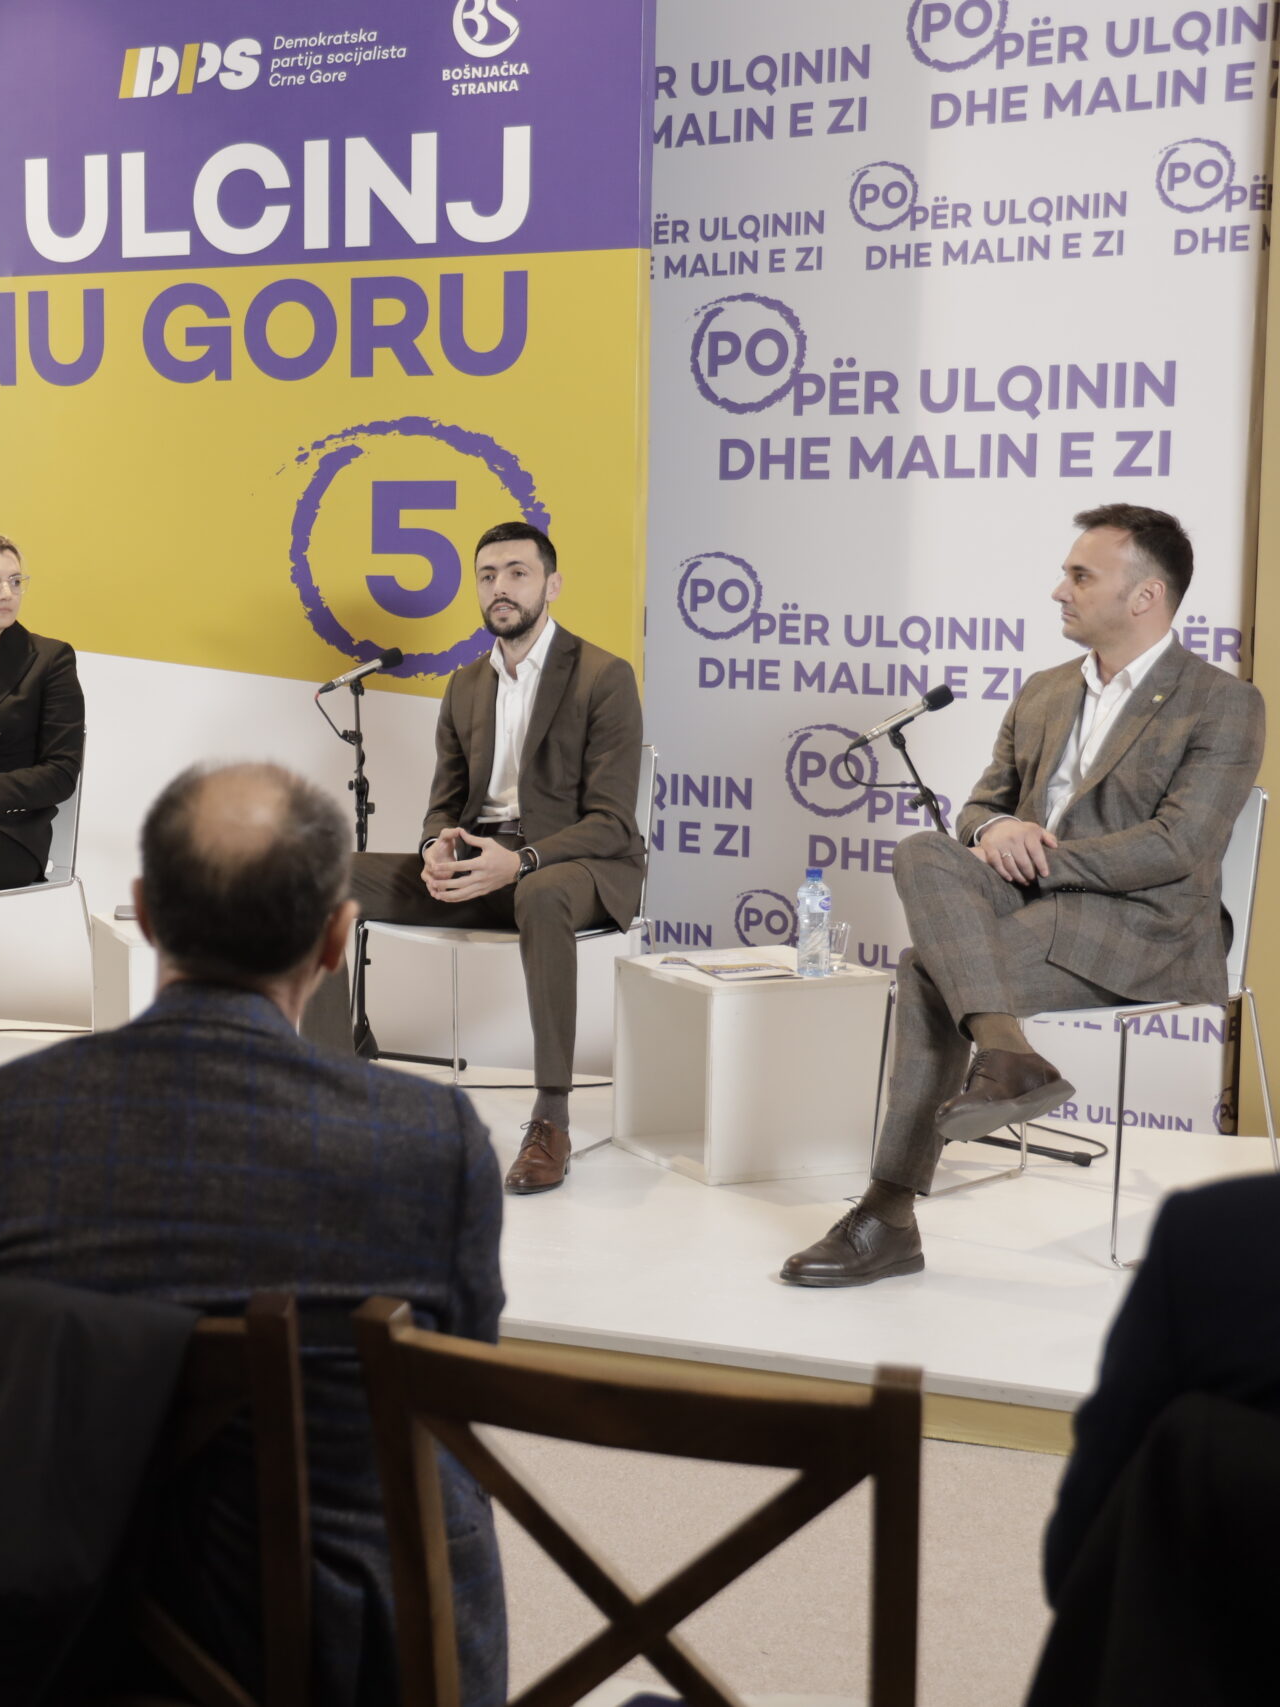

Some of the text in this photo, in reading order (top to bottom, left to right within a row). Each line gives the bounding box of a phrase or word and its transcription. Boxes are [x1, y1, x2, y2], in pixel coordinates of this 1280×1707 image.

[273, 28, 378, 51] Demokratska
[921, 0, 992, 43] PO
[271, 45, 408, 73] partija socijalista
[996, 16, 1089, 70] PËR
[118, 38, 262, 99] DPS
[269, 69, 347, 87] Crne Gore
[442, 61, 529, 81] BOŠNJAČKA
[451, 79, 519, 96] STRANKA
[691, 44, 870, 96] ULQININ
[930, 85, 1028, 130] DHE
[1043, 66, 1207, 119] MALIN
[1225, 61, 1255, 102] E
[789, 102, 814, 138] E
[827, 96, 867, 135] ZI
[25, 125, 531, 264] ULCINJ
[1167, 159, 1224, 192] PO
[860, 181, 908, 211] PO
[910, 190, 1128, 231] PËR ULQININ
[651, 210, 825, 245] ËR ULQININ
[1174, 224, 1251, 256] DHE
[663, 250, 758, 280] MALIN
[768, 248, 786, 274] E
[795, 246, 823, 272] ZI
[865, 229, 1125, 271] DHE MALIN E ZI
[142, 270, 528, 384] GORU
[707, 328, 789, 377] PO
[793, 357, 1177, 420] PËR ULQININ
[719, 430, 1172, 481] DHE MALIN E ZI
[365, 480, 461, 618] 5
[689, 578, 750, 613] PO
[752, 603, 1025, 656] PËR ULQININ
[1172, 615, 1242, 662] ËR
[698, 657, 1022, 700] DHE MALIN E ZI
[799, 751, 865, 790] PO
[678, 821, 701, 854] E
[713, 823, 750, 858] ZI
[808, 834, 898, 873] DHE
[641, 919, 712, 947] ININ
[743, 907, 788, 936] PO
[858, 942, 912, 969] UL
